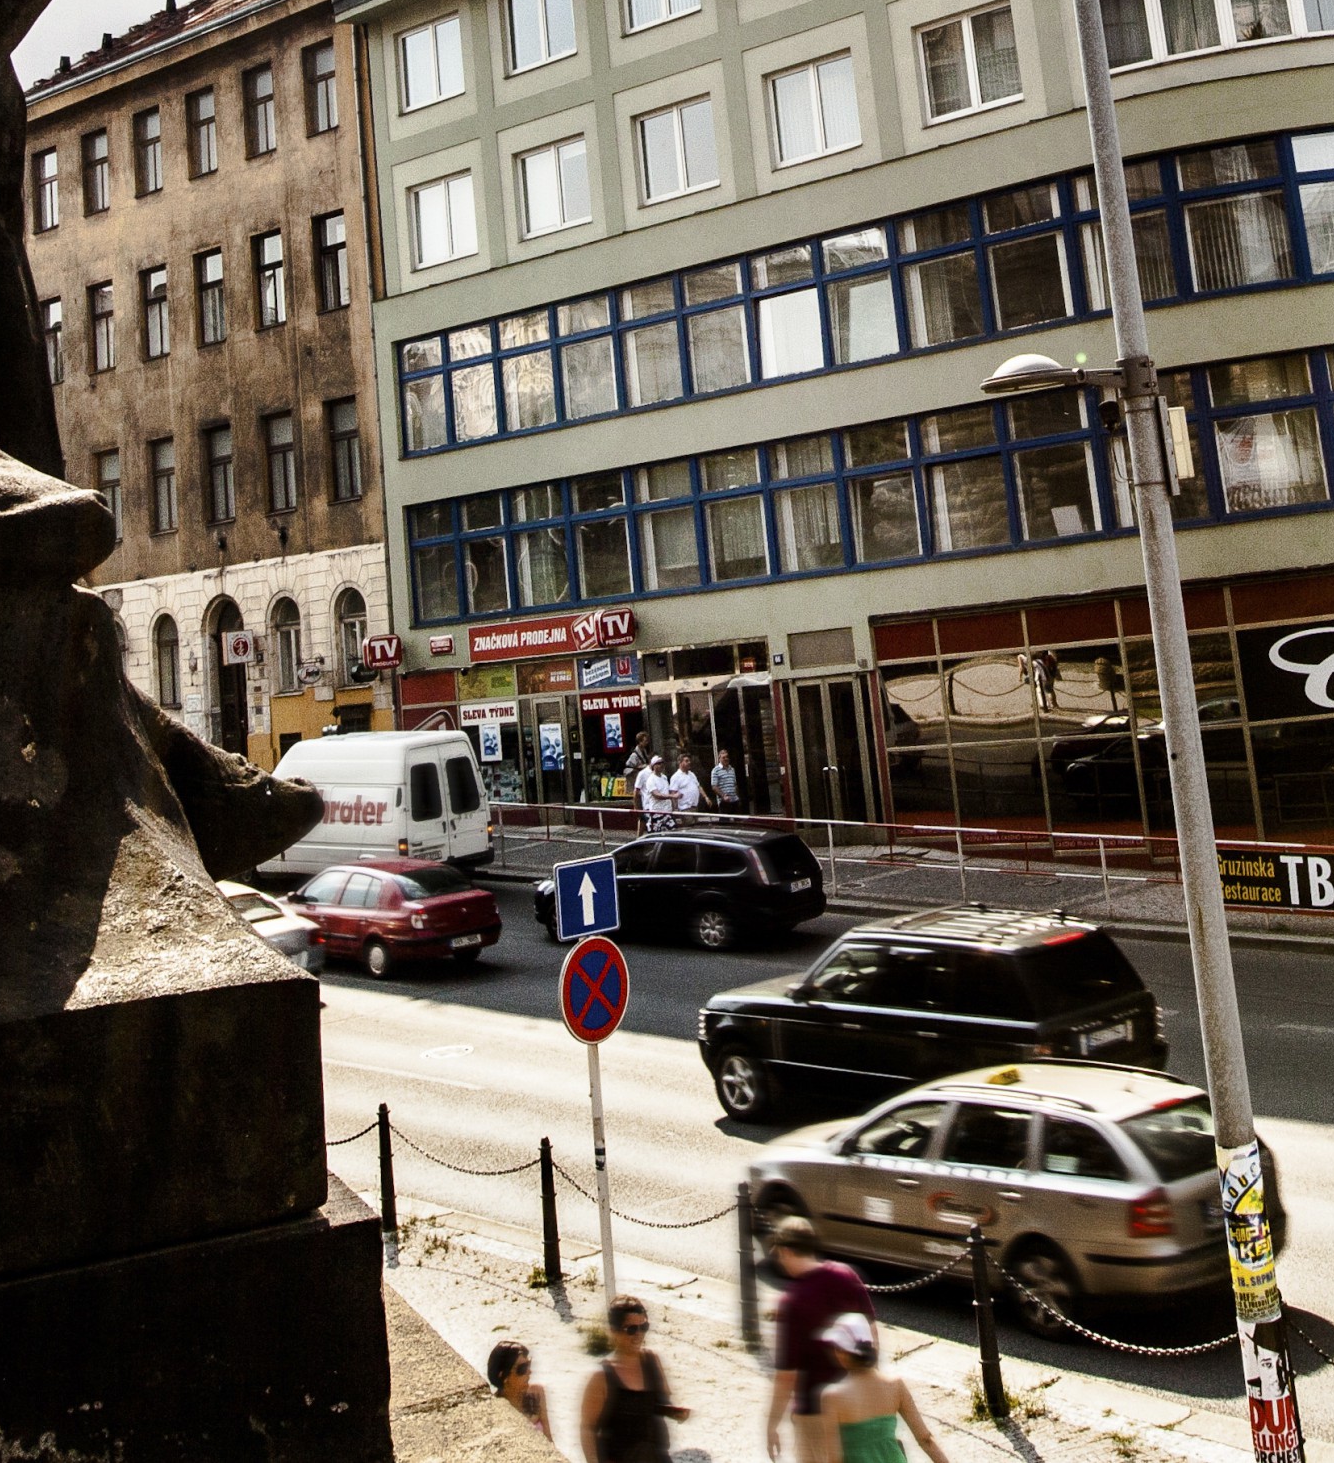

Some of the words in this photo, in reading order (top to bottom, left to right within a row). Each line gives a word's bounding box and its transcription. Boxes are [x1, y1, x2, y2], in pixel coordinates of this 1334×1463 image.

[602, 613, 630, 637] TV
[474, 630, 518, 652] ZNAČKOVÁ
[520, 627, 567, 647] PRODEJNA
[605, 636, 634, 645] PRODUCTS
[370, 639, 398, 660] TV
[372, 659, 400, 667] PRODUCTS
[582, 697, 609, 711] SLEVA
[611, 694, 641, 708] TÝDNE
[463, 708, 487, 721] SLEVA
[489, 705, 515, 718] TÝDNE
